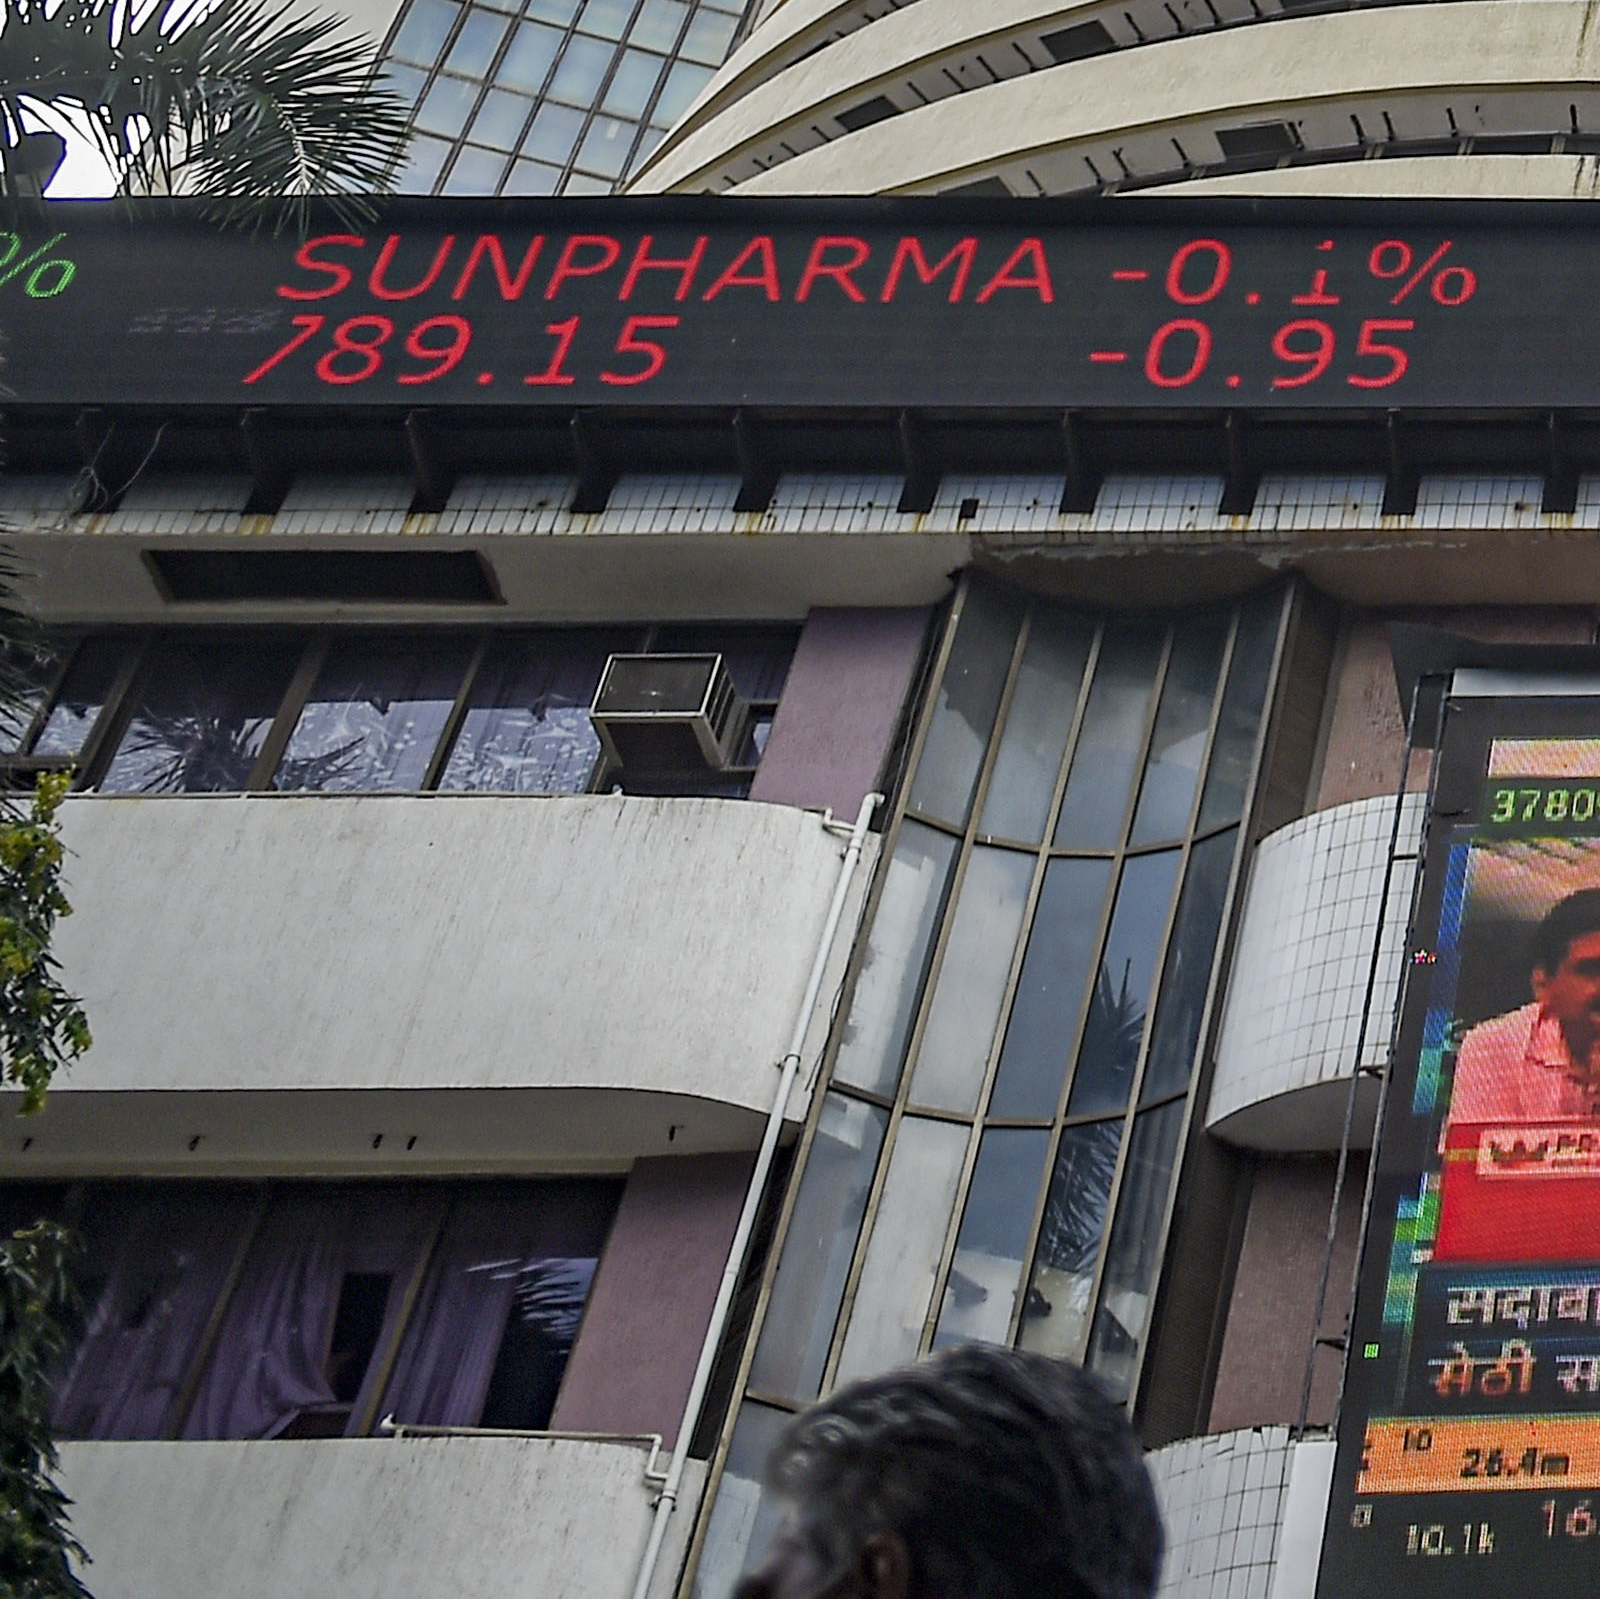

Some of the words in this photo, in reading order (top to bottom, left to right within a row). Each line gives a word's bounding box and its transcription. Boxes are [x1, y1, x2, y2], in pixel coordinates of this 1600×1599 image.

[276, 234, 1055, 304] SUNPHARMA
[242, 315, 679, 386] 789.15
[1089, 318, 1415, 388] -0.95
